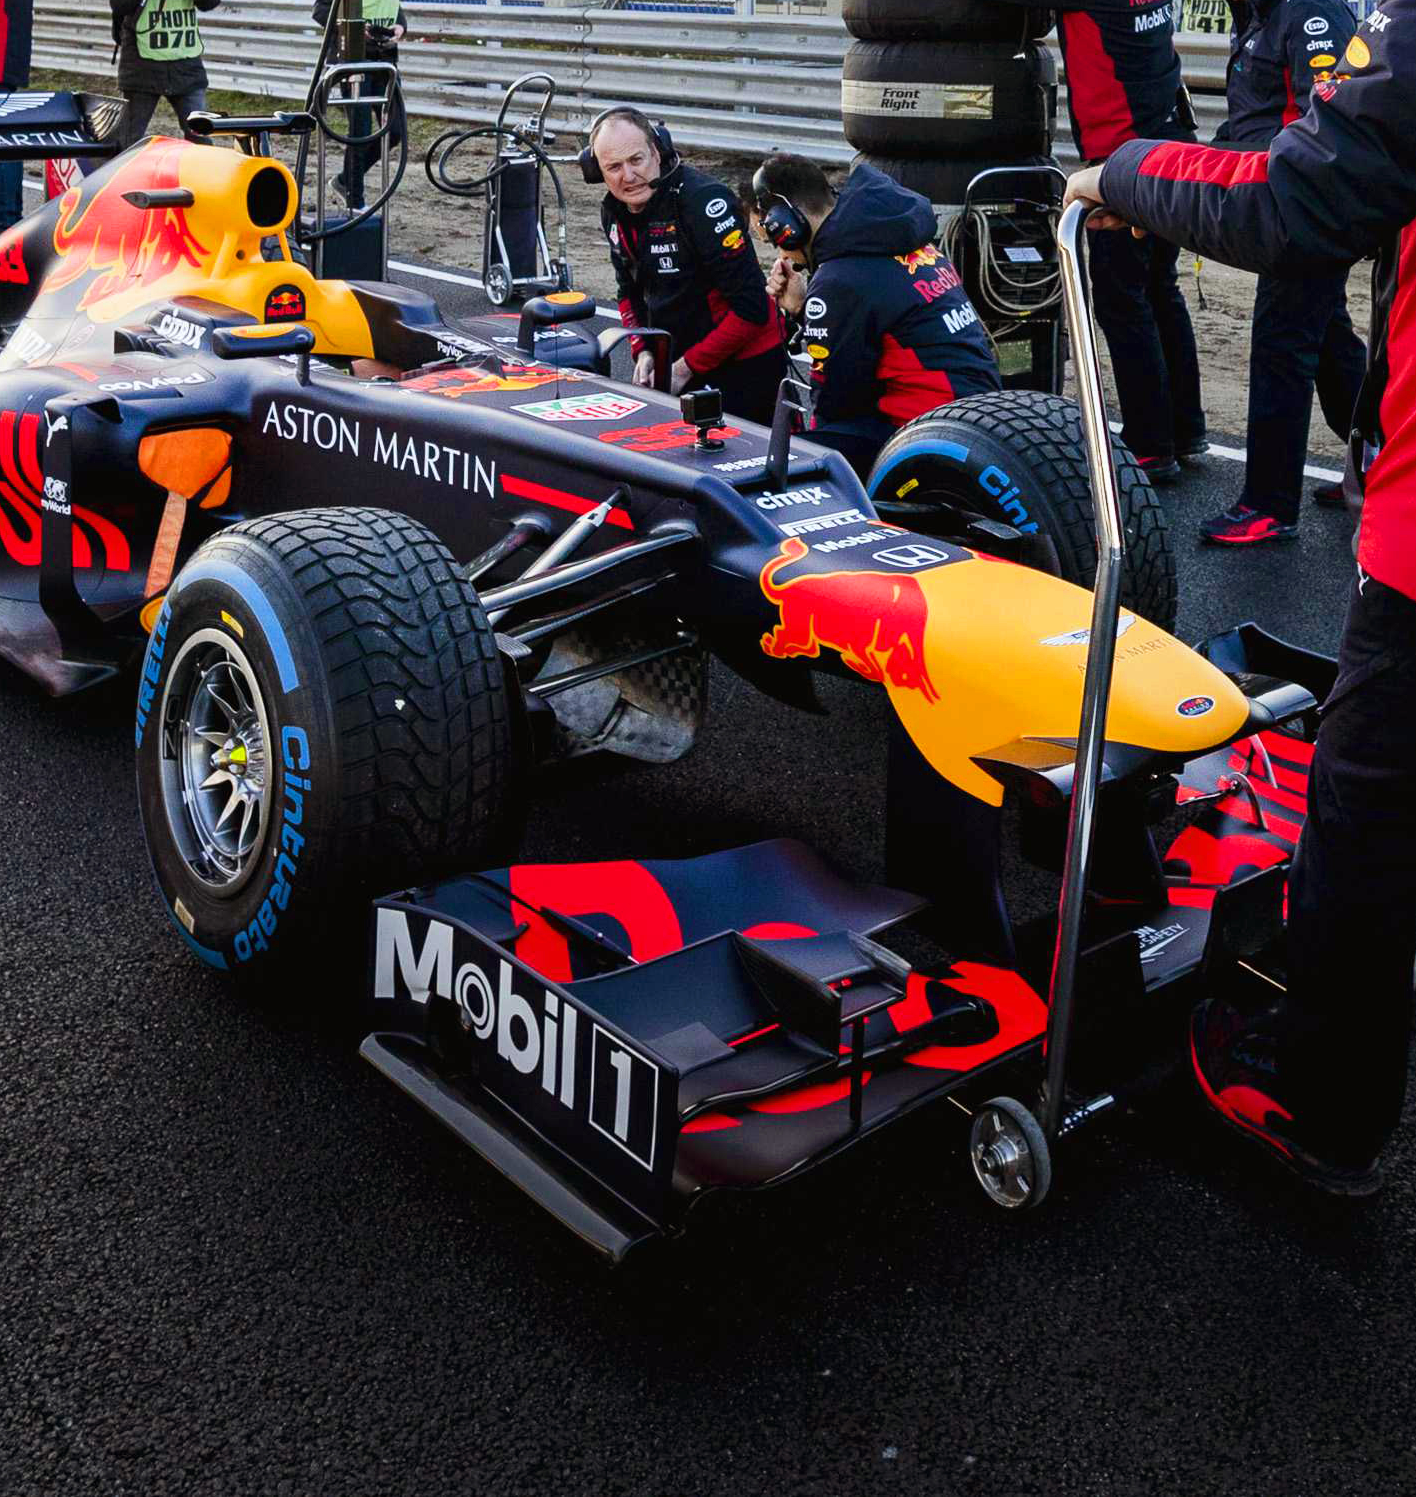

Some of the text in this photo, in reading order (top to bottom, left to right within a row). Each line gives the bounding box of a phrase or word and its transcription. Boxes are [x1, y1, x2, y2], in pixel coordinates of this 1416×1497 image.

[149, 8, 196, 28] PHOTO
[1135, 7, 1165, 32] Mobil
[150, 29, 196, 49] 070
[881, 99, 918, 111] Right
[883, 88, 920, 99] Front
[263, 400, 496, 500] ASTON MARTIN
[778, 508, 868, 537] PIRELLI
[812, 530, 883, 553] Mobil
[374, 906, 578, 1111] Mobil
